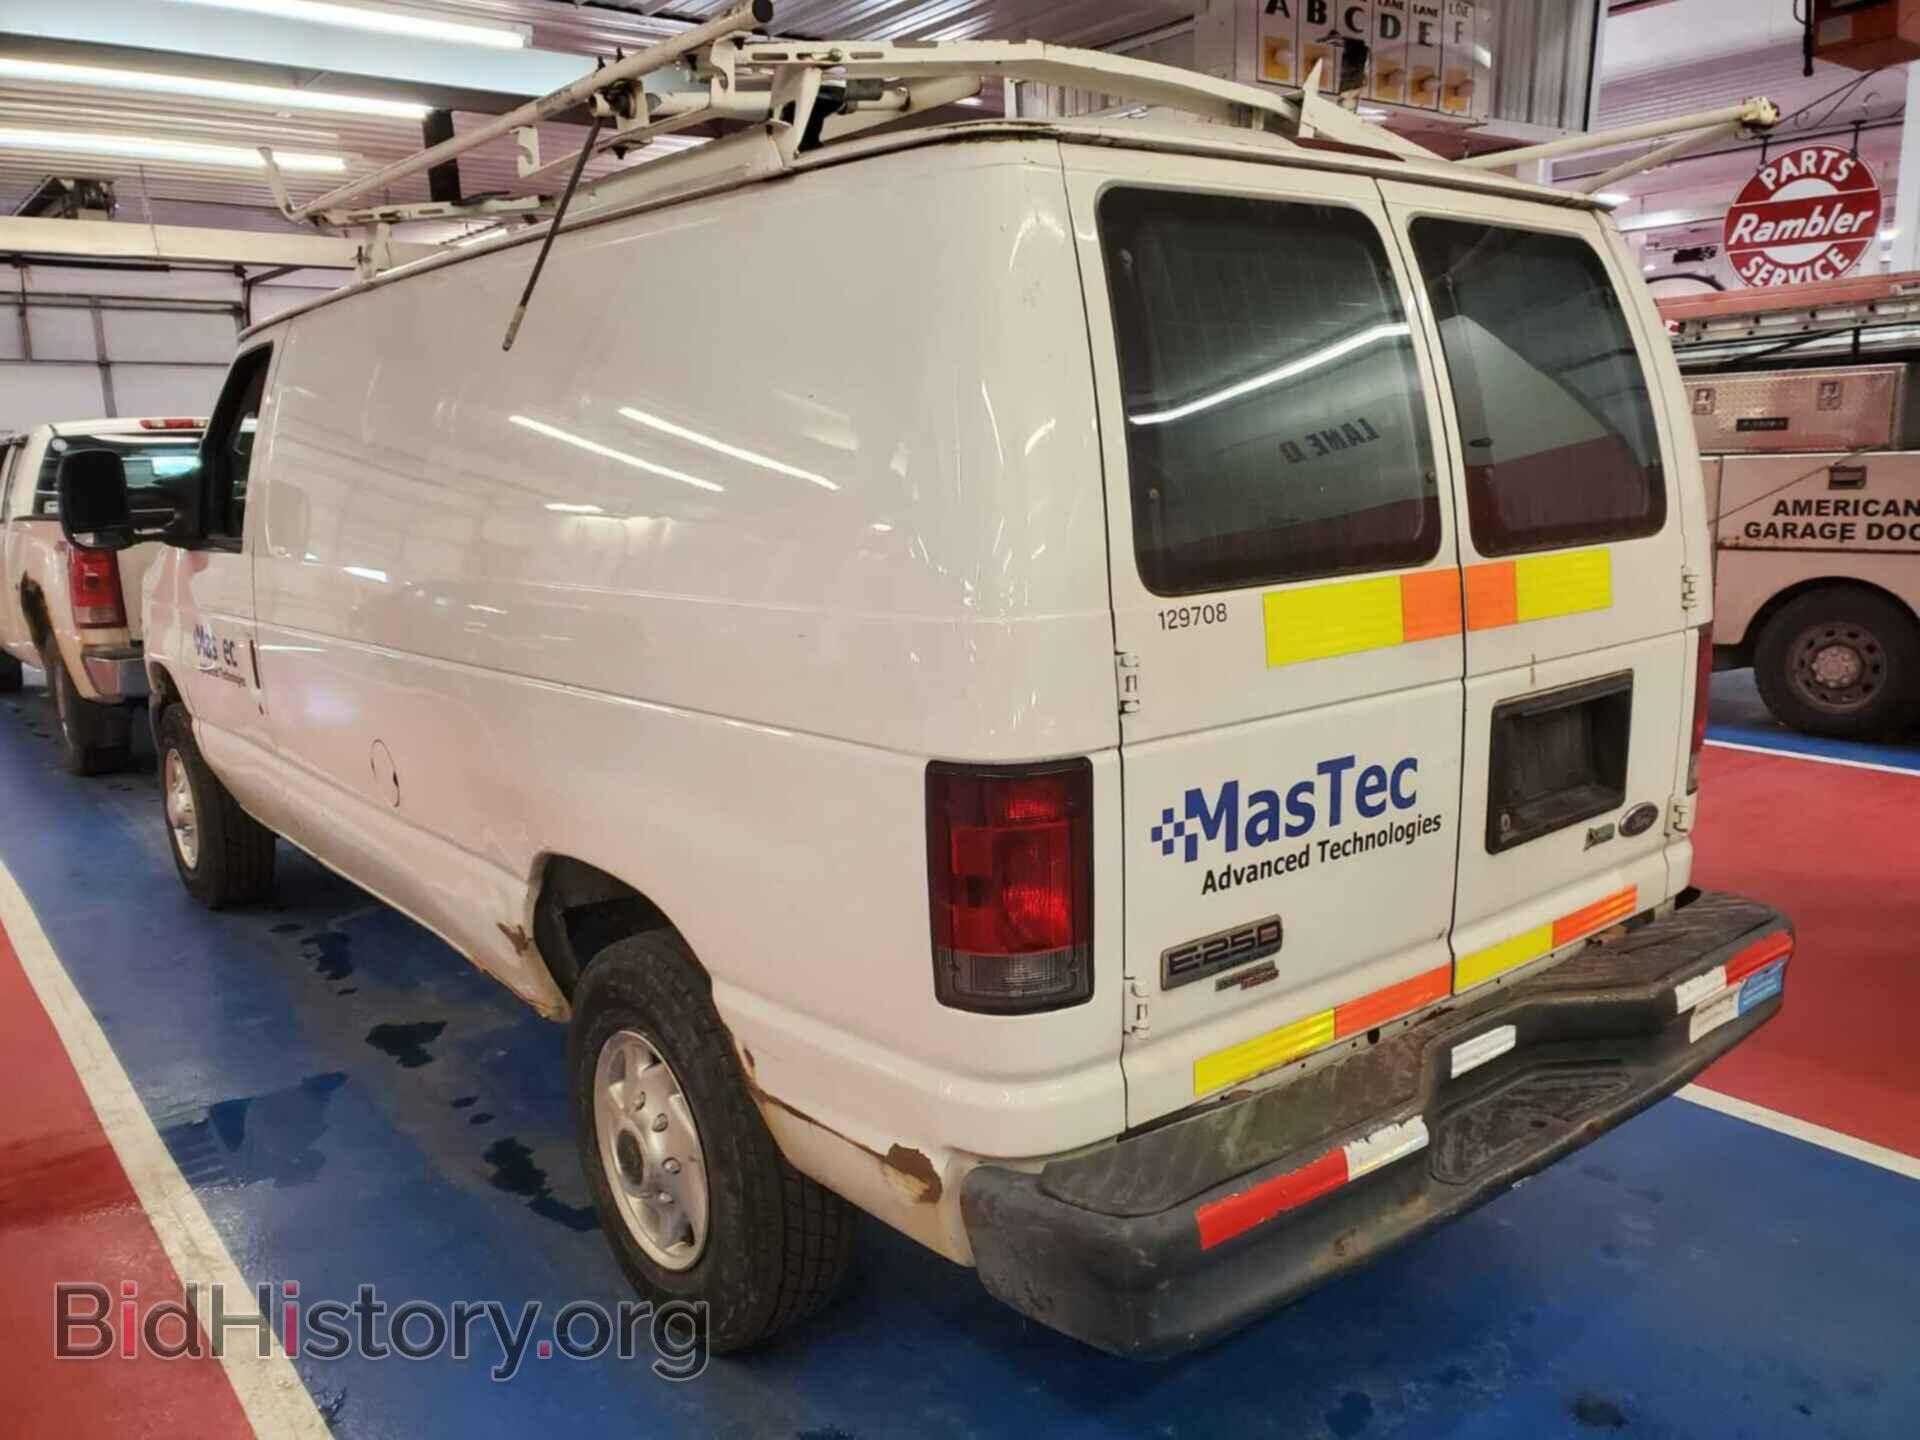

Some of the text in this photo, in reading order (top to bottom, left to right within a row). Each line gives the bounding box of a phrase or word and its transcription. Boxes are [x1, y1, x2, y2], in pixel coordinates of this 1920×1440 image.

[1265, 0, 1290, 18] A
[1306, 0, 1327, 25] B
[1344, 6, 1363, 33] C
[1412, 4, 1438, 17] LANE
[1379, 13, 1401, 39] D
[1418, 21, 1433, 47] E
[1454, 21, 1464, 44] F
[1758, 150, 1856, 191] PARTS
[1728, 203, 1874, 245] Rambler
[1741, 248, 1850, 288] SERVICE
[1773, 499, 1920, 517] AMERICAN
[1744, 522, 1857, 543] GARAGE
[1157, 602, 1228, 631] 129708
[192, 624, 238, 667] Masec
[1184, 755, 1418, 863] MasTec
[1201, 813, 1442, 896] Advanced Technologies
